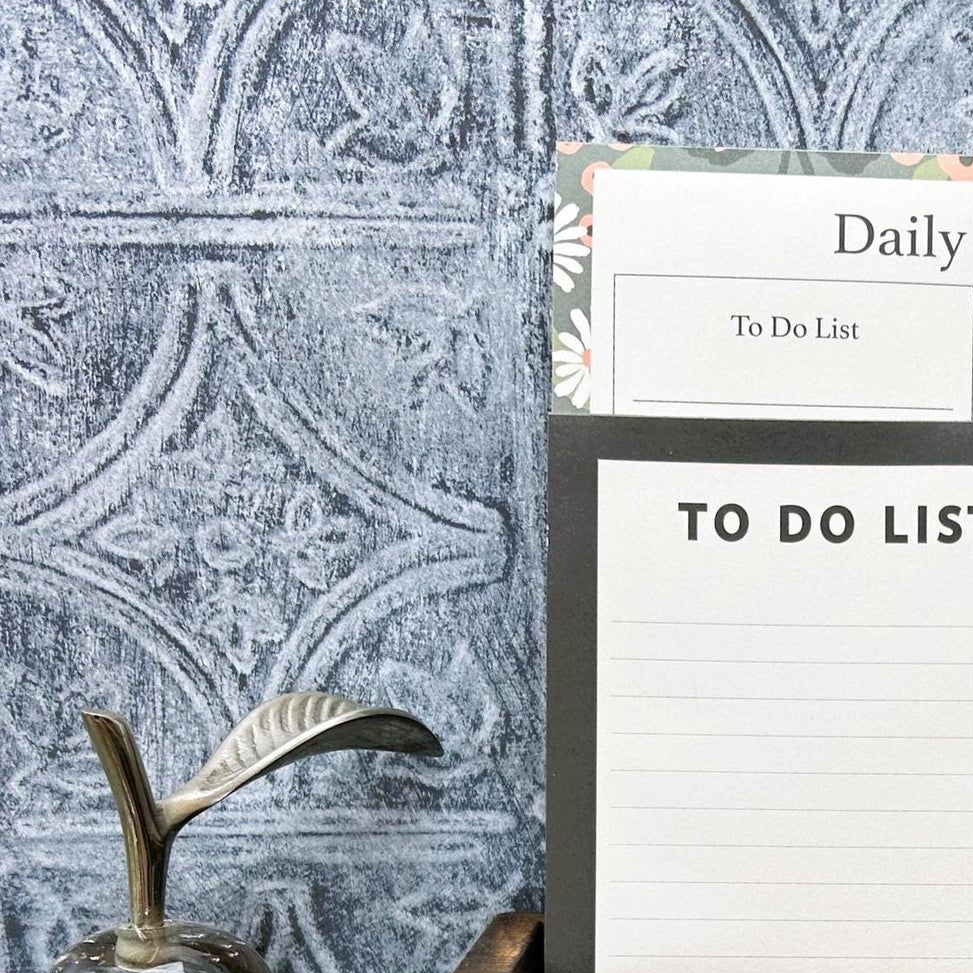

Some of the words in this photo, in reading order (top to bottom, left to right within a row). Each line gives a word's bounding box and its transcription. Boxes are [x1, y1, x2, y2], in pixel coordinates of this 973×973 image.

[834, 213, 967, 272] Daily
[730, 314, 763, 337] To
[772, 316, 807, 338] Do
[816, 317, 859, 340] List
[677, 502, 750, 543] TO
[779, 504, 855, 544] DO
